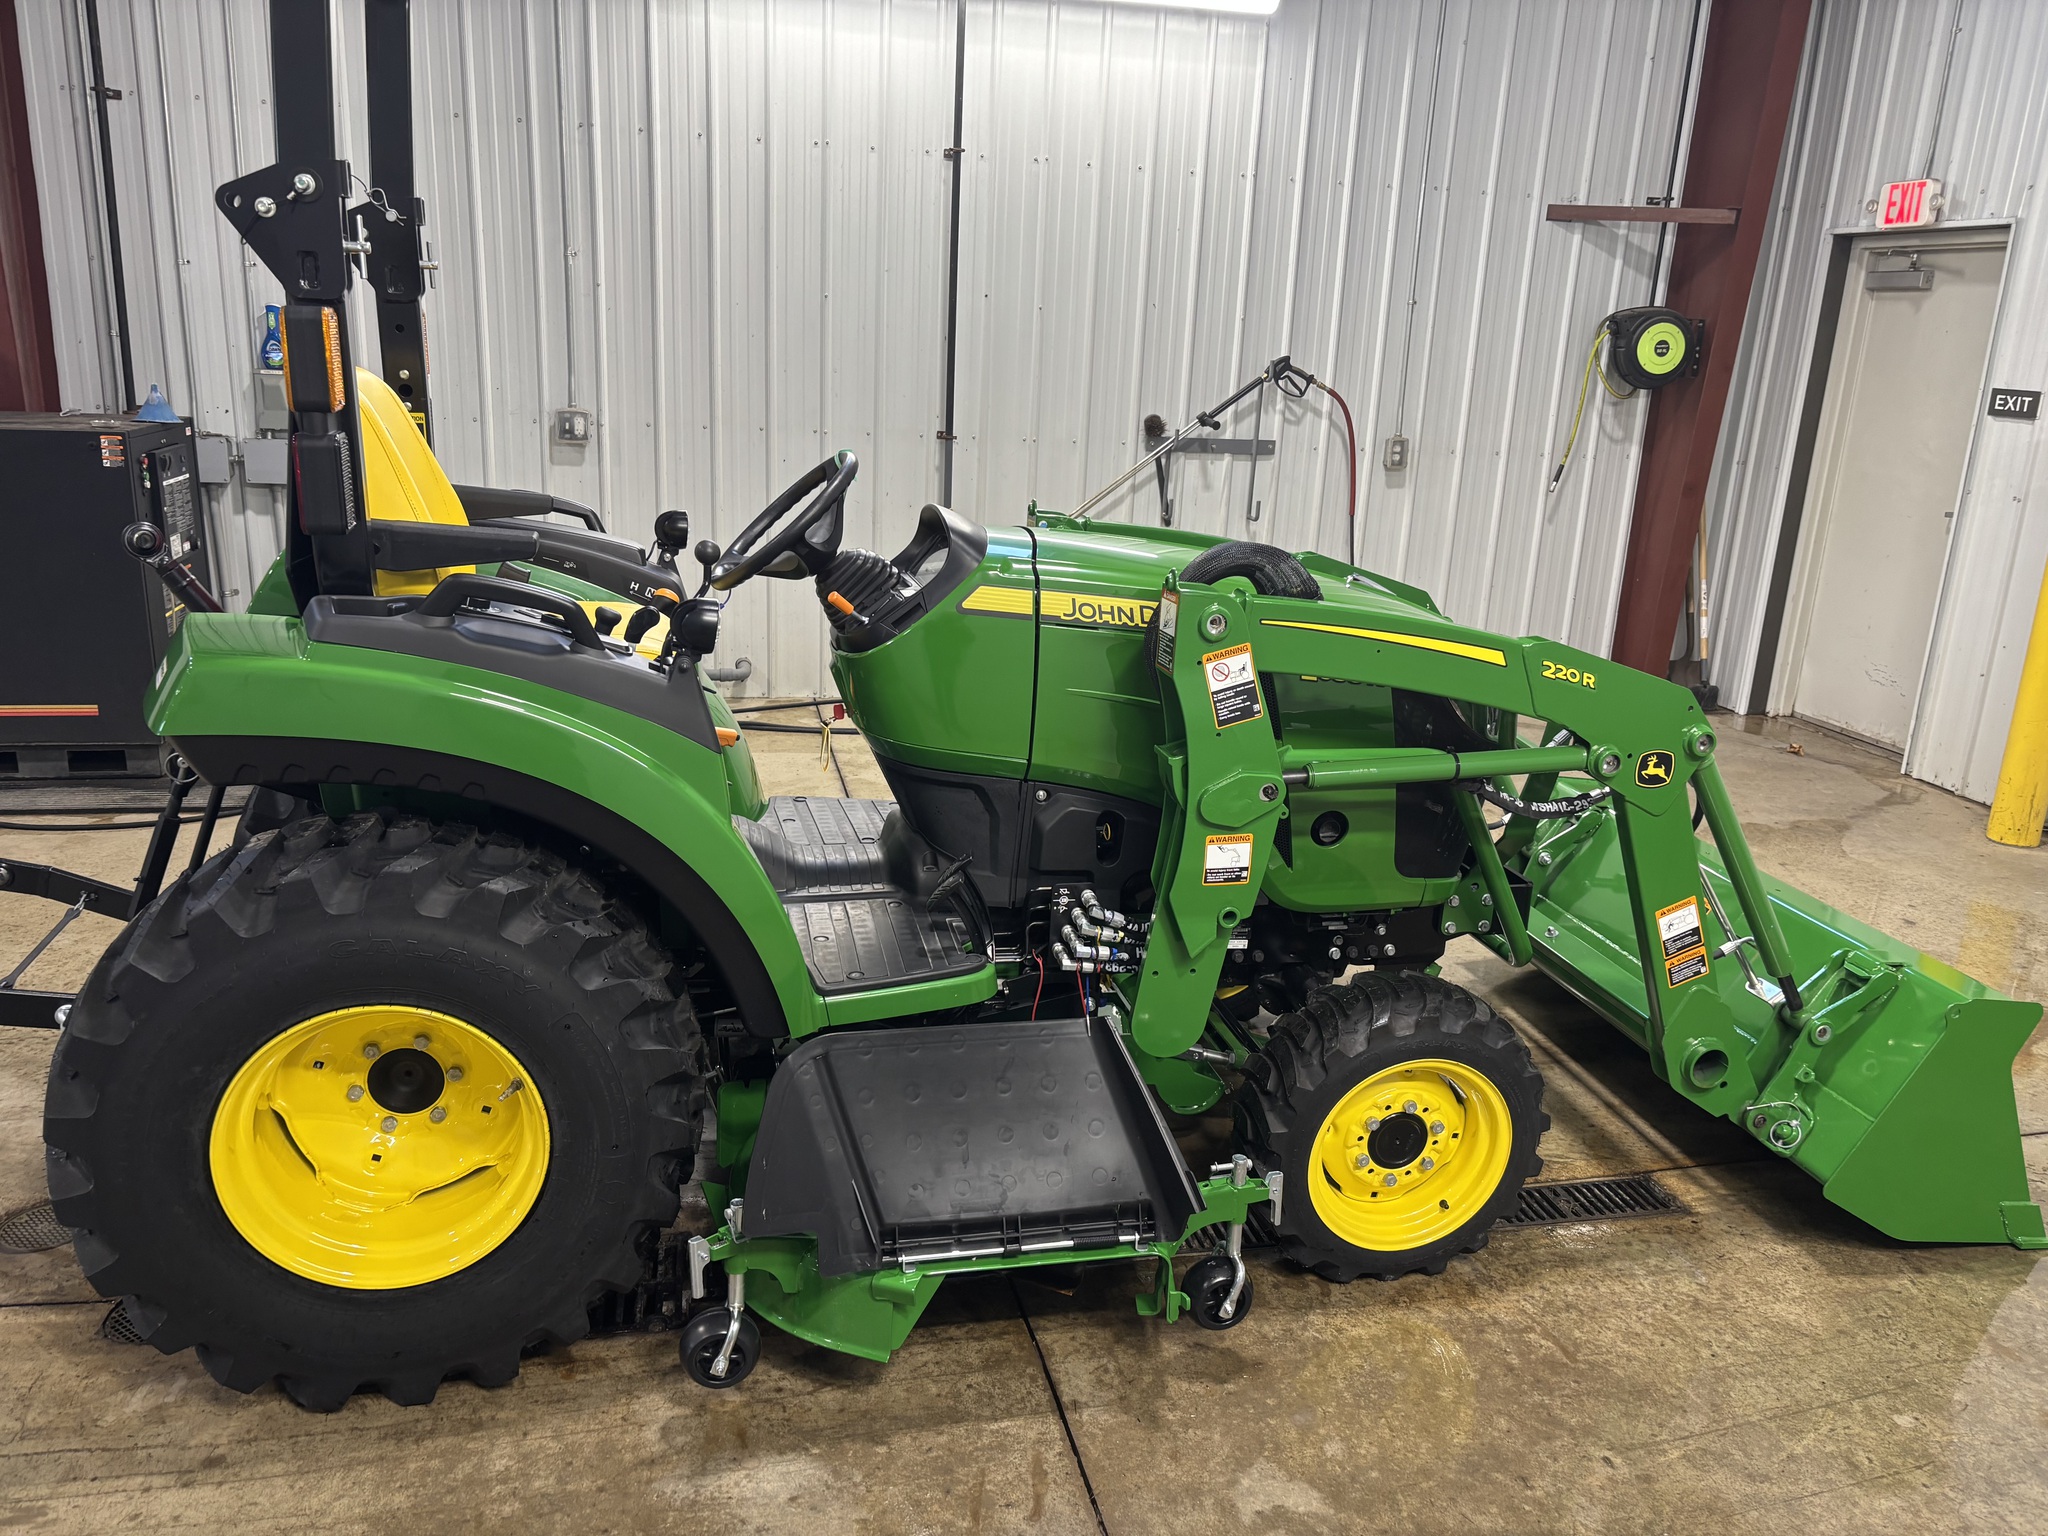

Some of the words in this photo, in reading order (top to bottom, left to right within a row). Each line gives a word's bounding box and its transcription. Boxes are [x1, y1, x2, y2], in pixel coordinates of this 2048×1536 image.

[1884, 181, 1928, 225] EXIT
[1994, 394, 2033, 412] EXIT
[629, 581, 639, 591] H
[1062, 597, 1135, 624] JOHN
[1212, 644, 1249, 660] WARNING
[1215, 834, 1251, 843] WARNING
[1666, 899, 1692, 914] WARNING
[1675, 950, 1702, 963] WARNING
